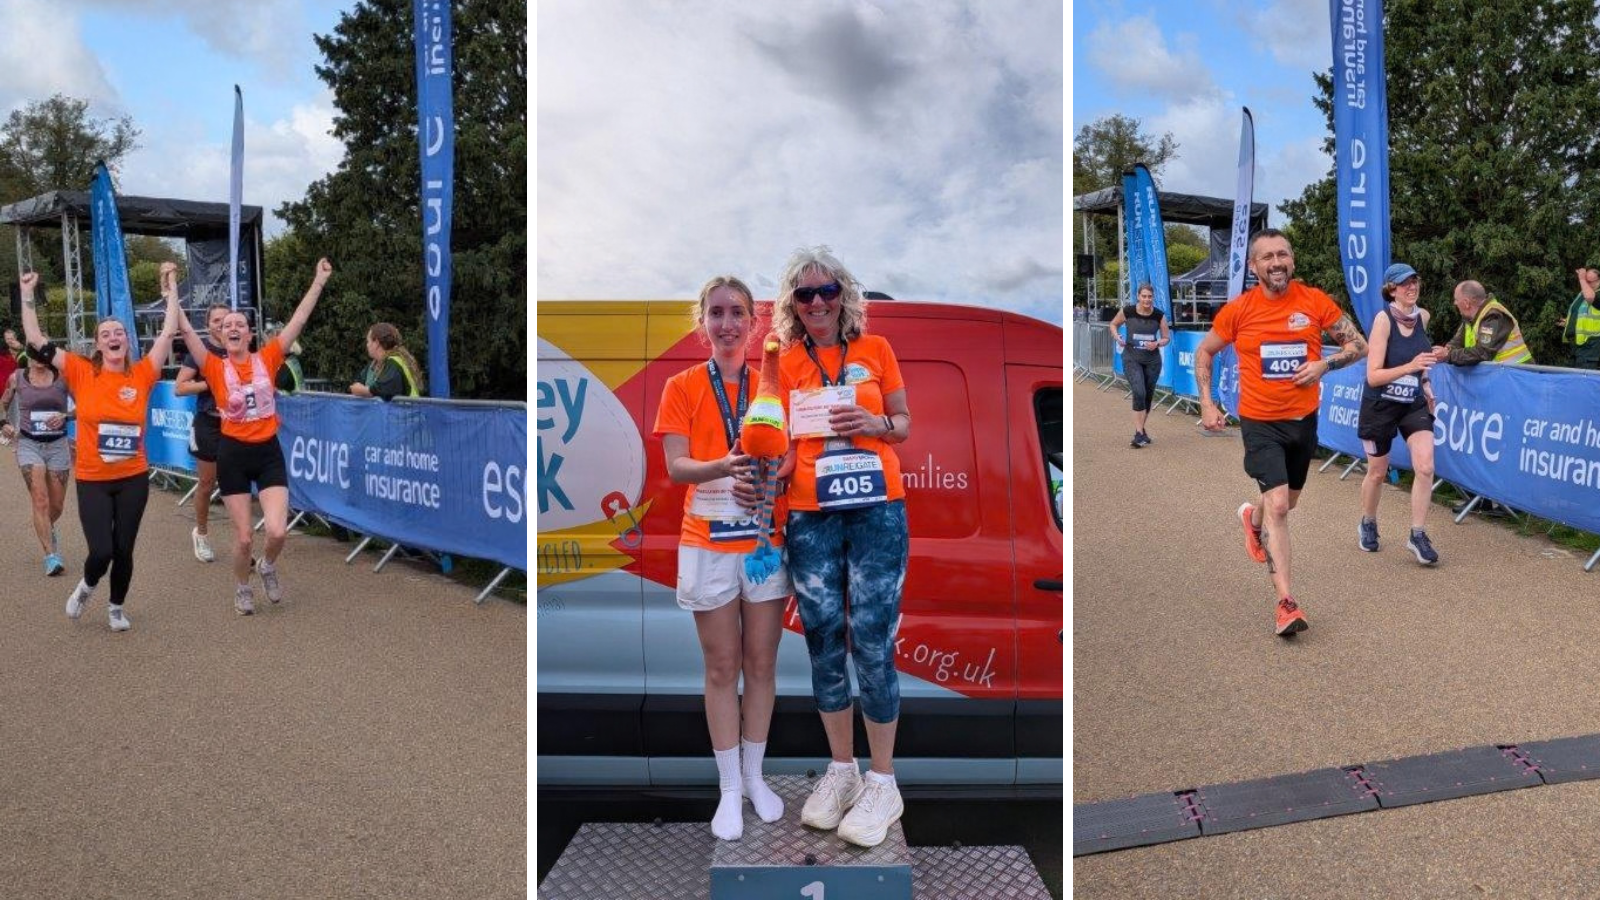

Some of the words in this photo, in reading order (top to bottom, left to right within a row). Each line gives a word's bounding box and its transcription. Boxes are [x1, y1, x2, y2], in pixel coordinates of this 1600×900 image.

[1270, 360, 1300, 372] 409
[105, 437, 132, 449] 422
[1523, 418, 1548, 438] car
[1549, 419, 1584, 446] and
[290, 435, 351, 489] esure
[365, 445, 382, 463] car
[384, 446, 404, 466] and
[406, 447, 439, 472] home
[364, 464, 441, 509] insurance
[483, 460, 527, 523] es
[828, 475, 873, 496] 405
